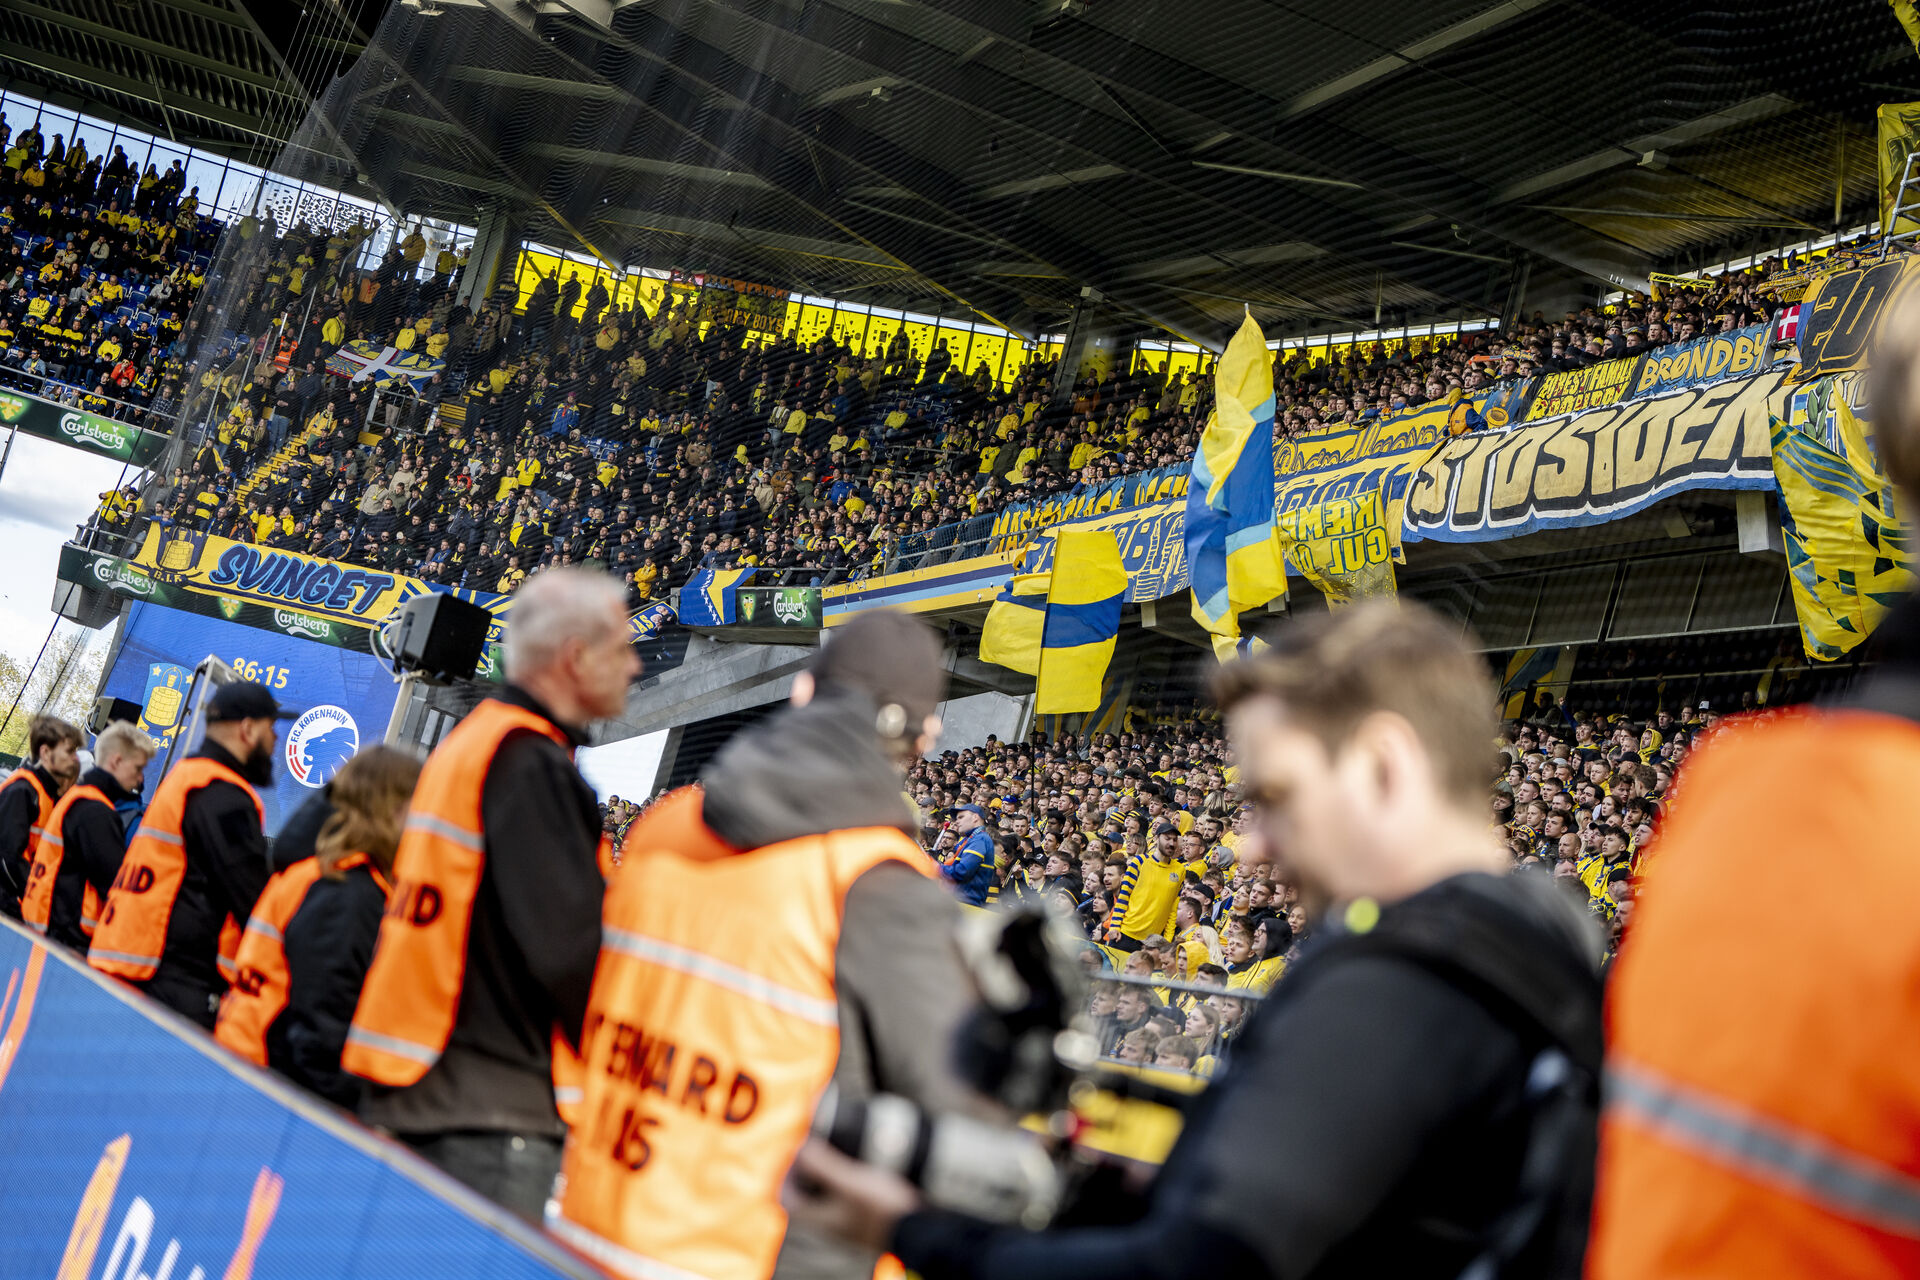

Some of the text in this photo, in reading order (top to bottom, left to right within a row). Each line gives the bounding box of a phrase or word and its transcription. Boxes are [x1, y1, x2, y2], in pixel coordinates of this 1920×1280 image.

[1636, 328, 1773, 393] BRØNDBY
[60, 412, 125, 449] Carlsberg
[93, 557, 157, 594] Carlsberg
[208, 543, 396, 615] SVINGET
[274, 608, 330, 637] Carlsberg
[773, 591, 807, 624] Carlsberg
[232, 657, 290, 689] 86:15
[298, 708, 348, 730] KØBENHAVN
